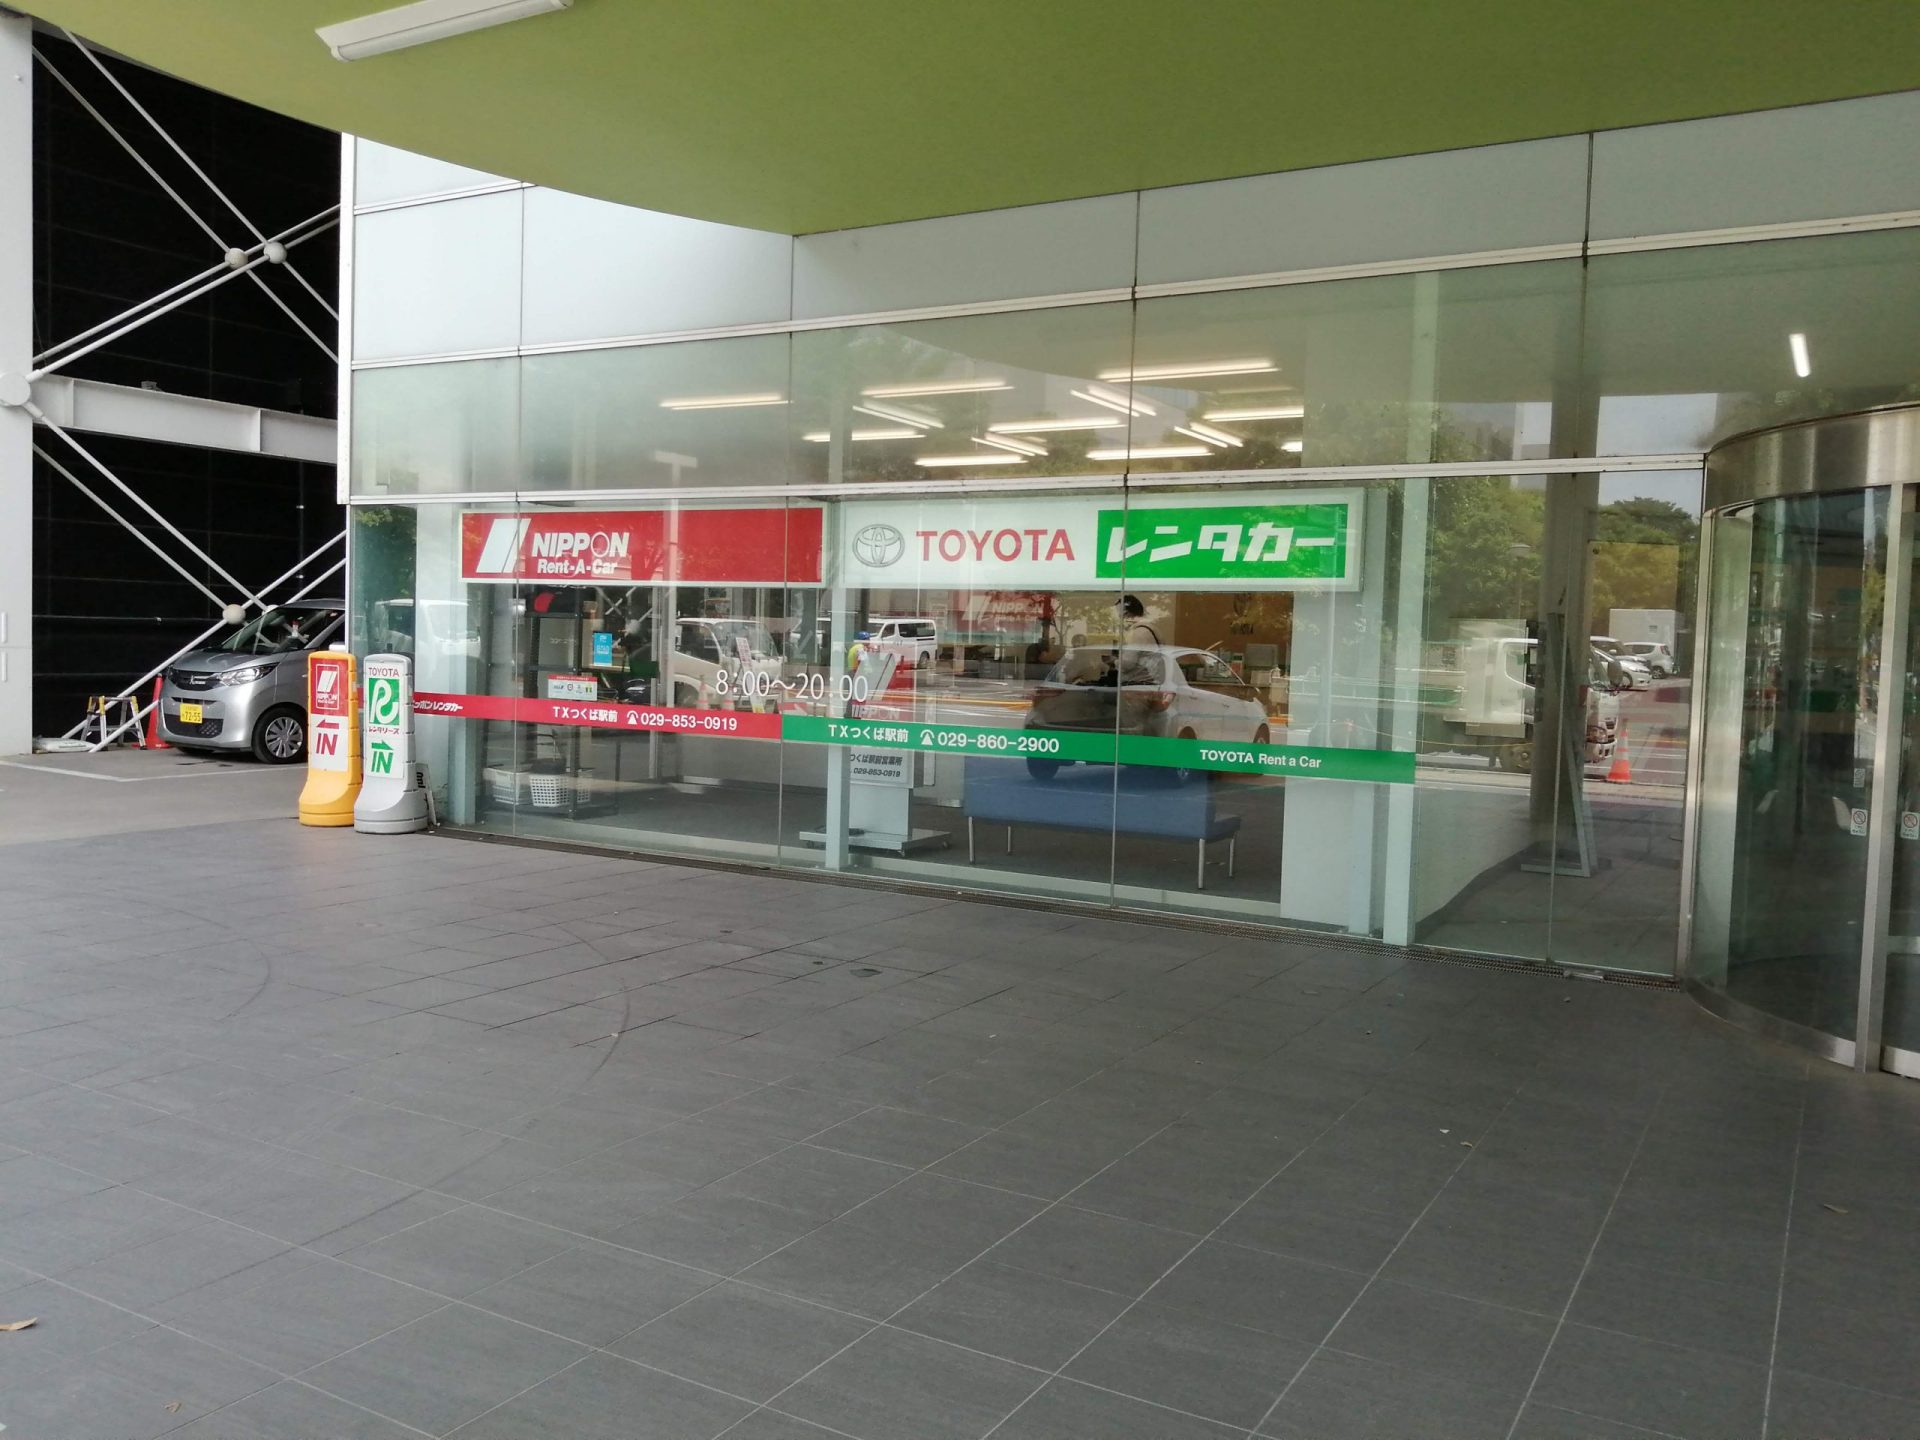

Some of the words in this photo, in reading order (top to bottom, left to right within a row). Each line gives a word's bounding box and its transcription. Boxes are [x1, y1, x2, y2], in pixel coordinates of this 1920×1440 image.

[532, 532, 630, 558] NIPPON
[915, 528, 1075, 562] TOYOTA
[1105, 521, 1335, 563] レンタカー
[537, 558, 618, 574] Rent-A-Car
[368, 667, 399, 677] TOYOTA
[552, 706, 618, 723] TXつくば駅前
[640, 712, 738, 731] 029-853-0919
[316, 733, 339, 756] IN
[828, 724, 910, 743] TXつくば駅前
[937, 731, 1060, 753] 029-860-2900
[371, 750, 394, 774] IN
[1199, 749, 1255, 764] TOYOTA
[1258, 753, 1287, 766] Rent
[1289, 759, 1297, 767] a
[1299, 755, 1322, 769] Car
